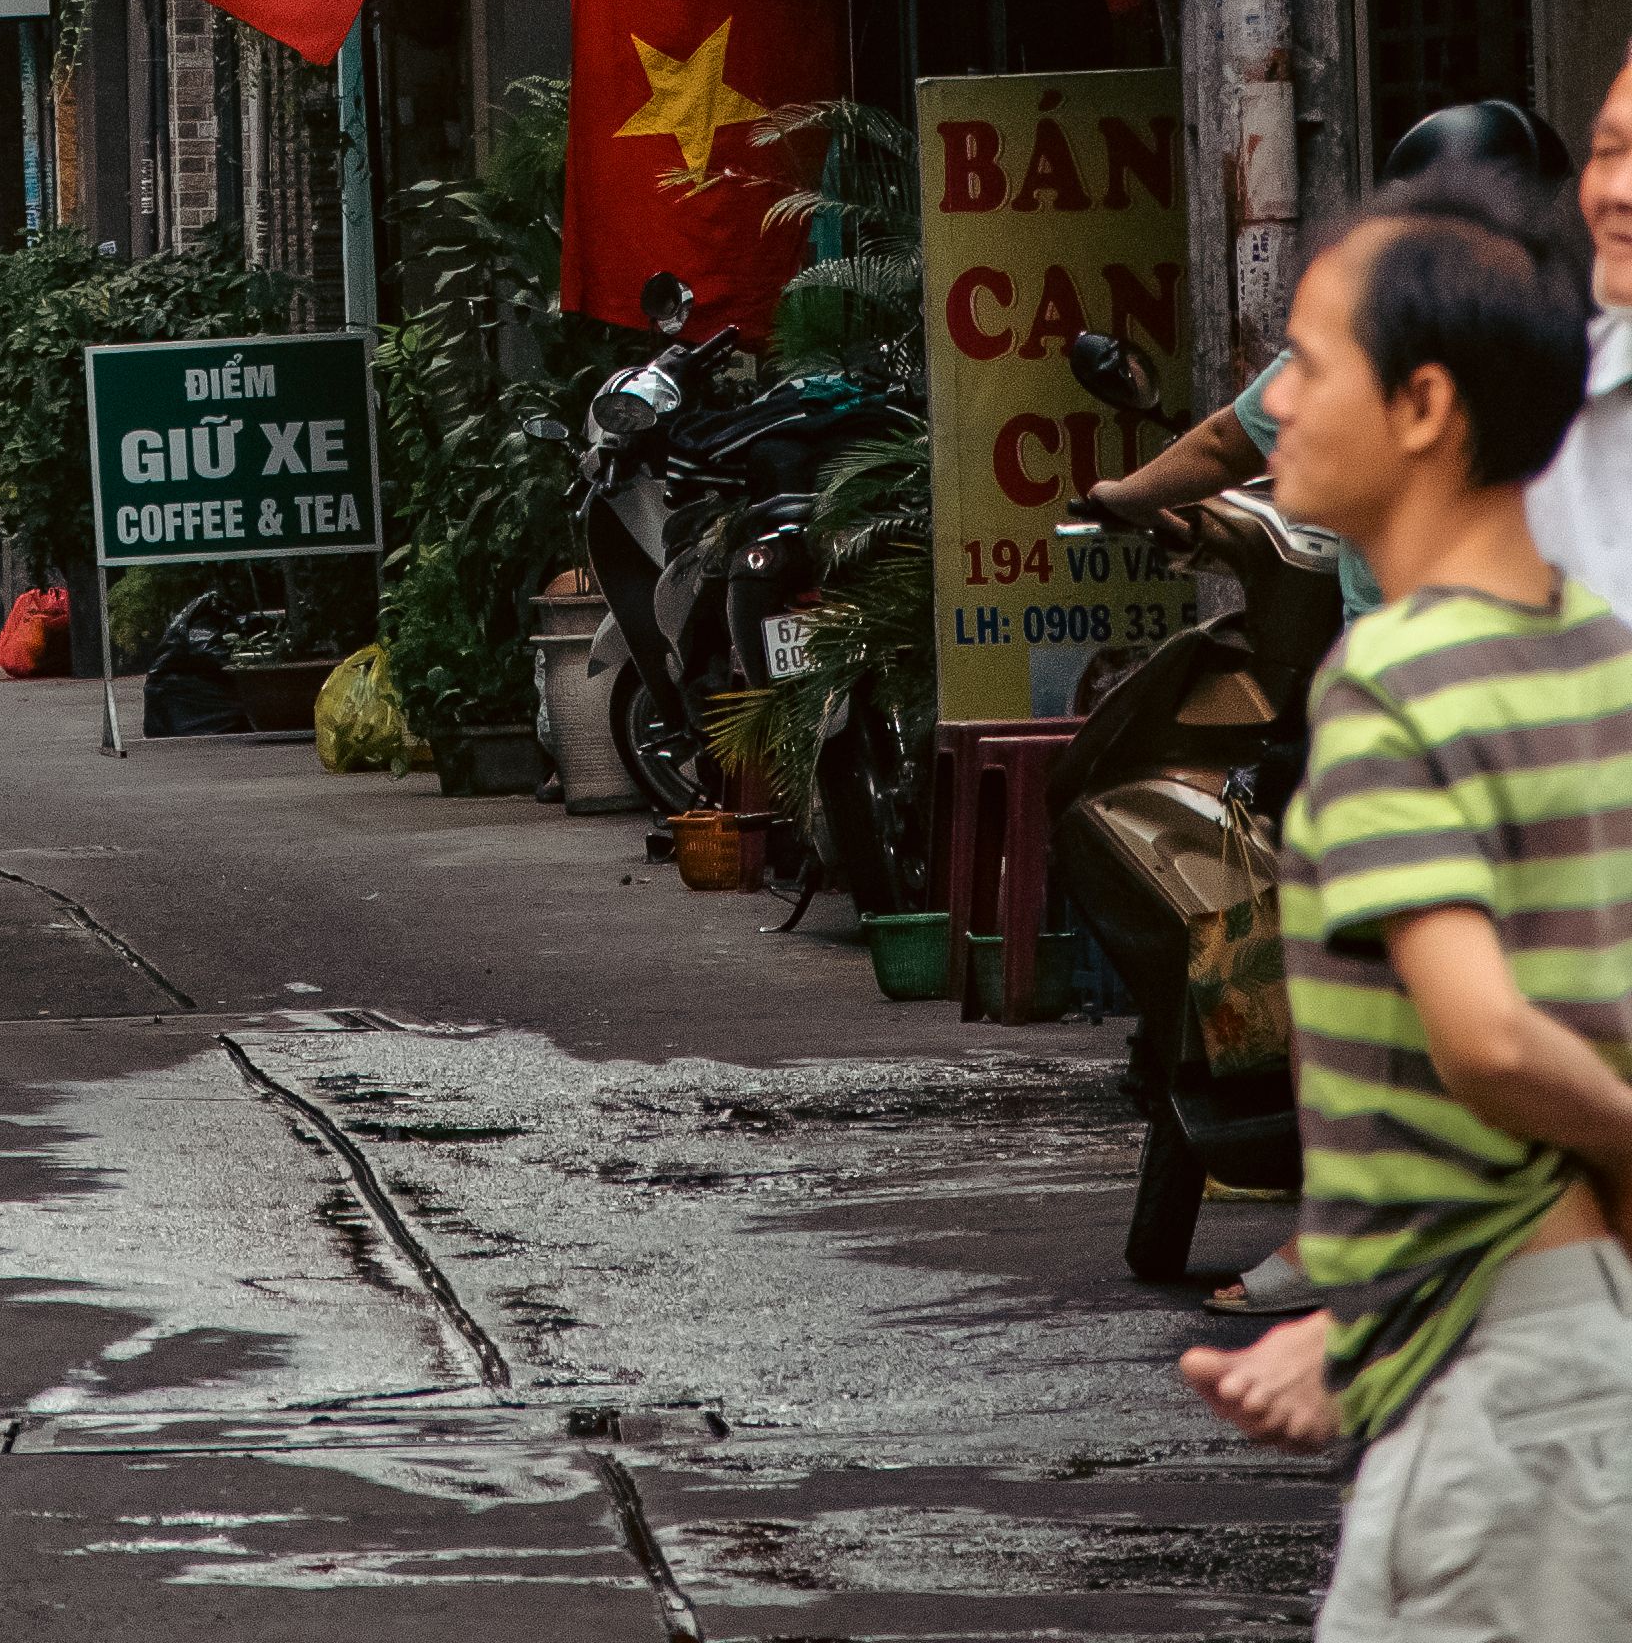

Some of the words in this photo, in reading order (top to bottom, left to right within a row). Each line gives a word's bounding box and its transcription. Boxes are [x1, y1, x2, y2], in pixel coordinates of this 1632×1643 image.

[184, 353, 276, 402] ĐIỂM
[120, 414, 244, 484] GIỮ
[259, 419, 349, 476] XE
[117, 499, 245, 545] COFFEE
[257, 497, 283, 537] &
[294, 494, 361, 534] TEA
[964, 538, 1054, 586] 194
[954, 605, 1011, 645] LH:
[1023, 604, 1113, 644] 0908
[1124, 603, 1168, 641] 33
